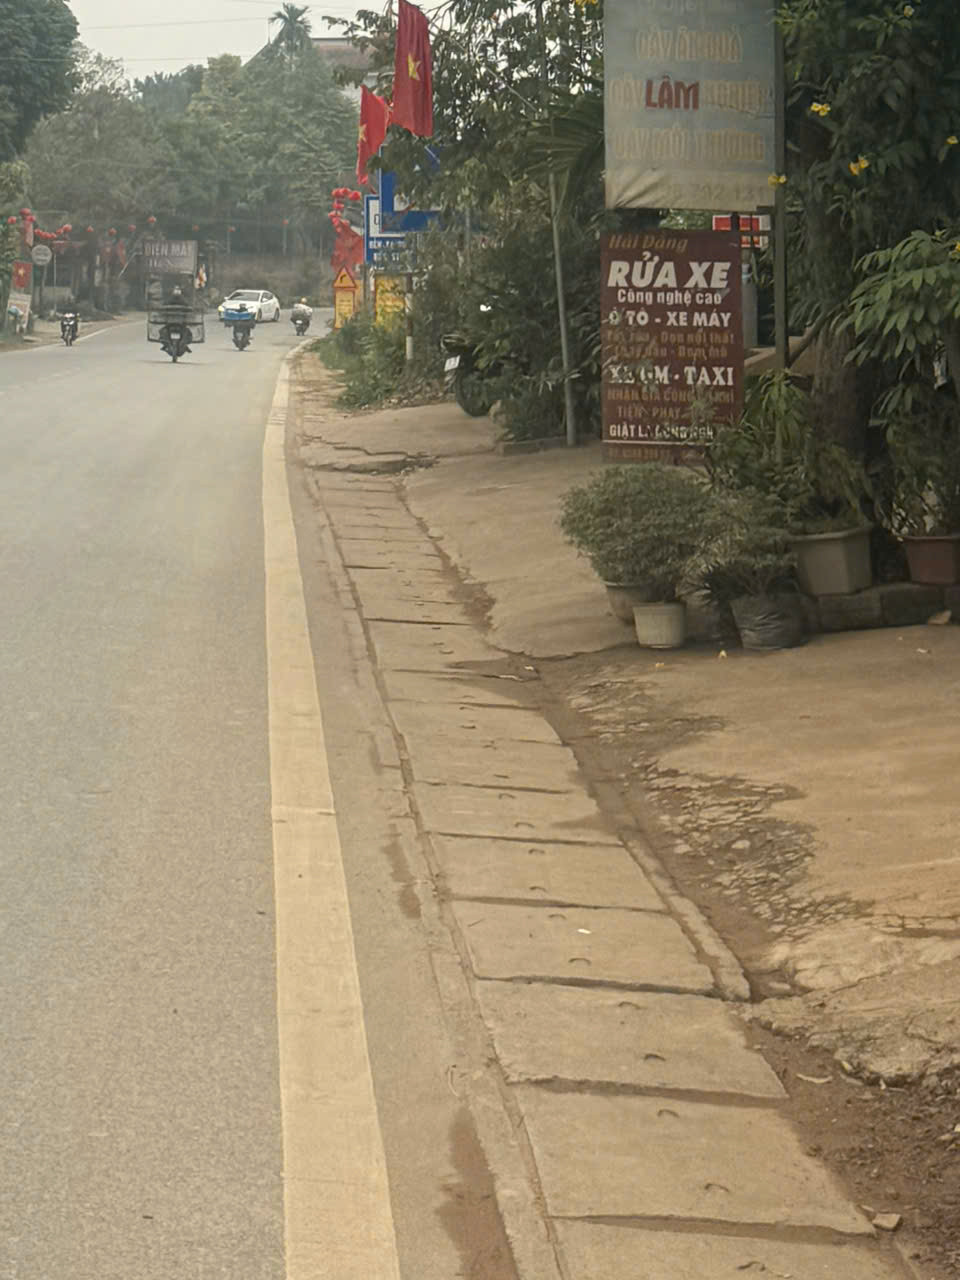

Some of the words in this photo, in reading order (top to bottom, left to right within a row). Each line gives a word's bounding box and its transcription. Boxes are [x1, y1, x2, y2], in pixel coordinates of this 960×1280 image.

[645, 75, 701, 111] LÂM
[607, 251, 678, 288] RỬA
[683, 261, 732, 289] XE
[617, 289, 653, 306] Công
[657, 289, 692, 307] nghệ
[696, 291, 722, 305] cao
[666, 310, 688, 327] XE
[693, 308, 732, 327] MÁY
[683, 366, 734, 386] TAXI
